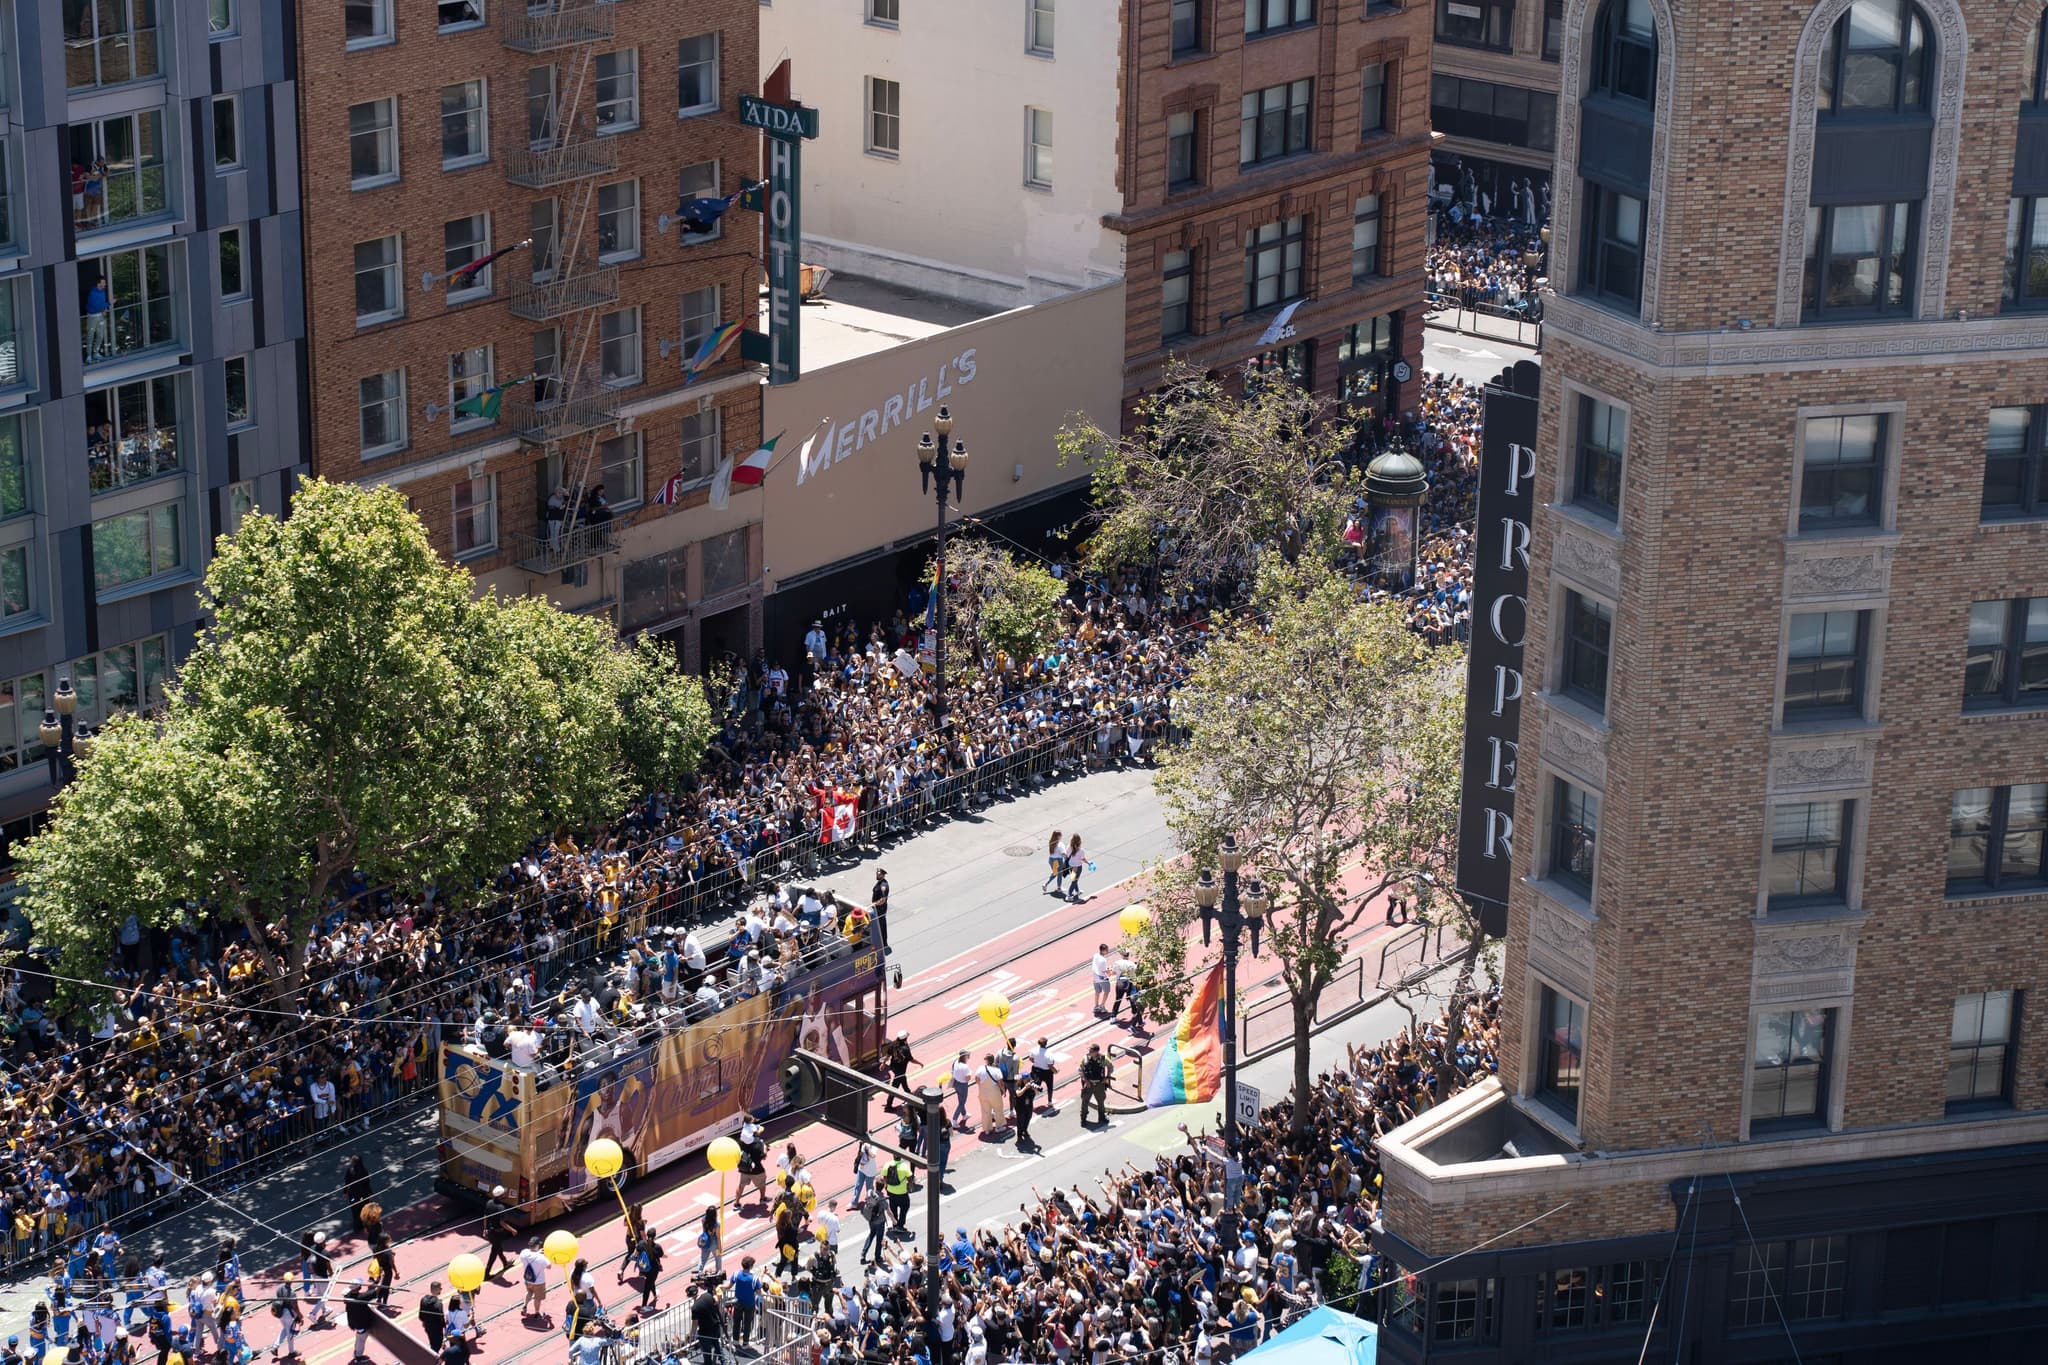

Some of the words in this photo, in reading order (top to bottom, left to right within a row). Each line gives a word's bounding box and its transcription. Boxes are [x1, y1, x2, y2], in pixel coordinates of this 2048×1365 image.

[745, 101, 804, 134] AIDA
[770, 140, 792, 372] HOTEL
[796, 347, 977, 487] MERRILL'S
[823, 603, 848, 619] BAIT
[1483, 443, 1536, 861] PROPER
[1238, 1085, 1258, 1098] SPEED
[1239, 1093, 1256, 1105] LIMIT
[1240, 1102, 1254, 1118] 10
